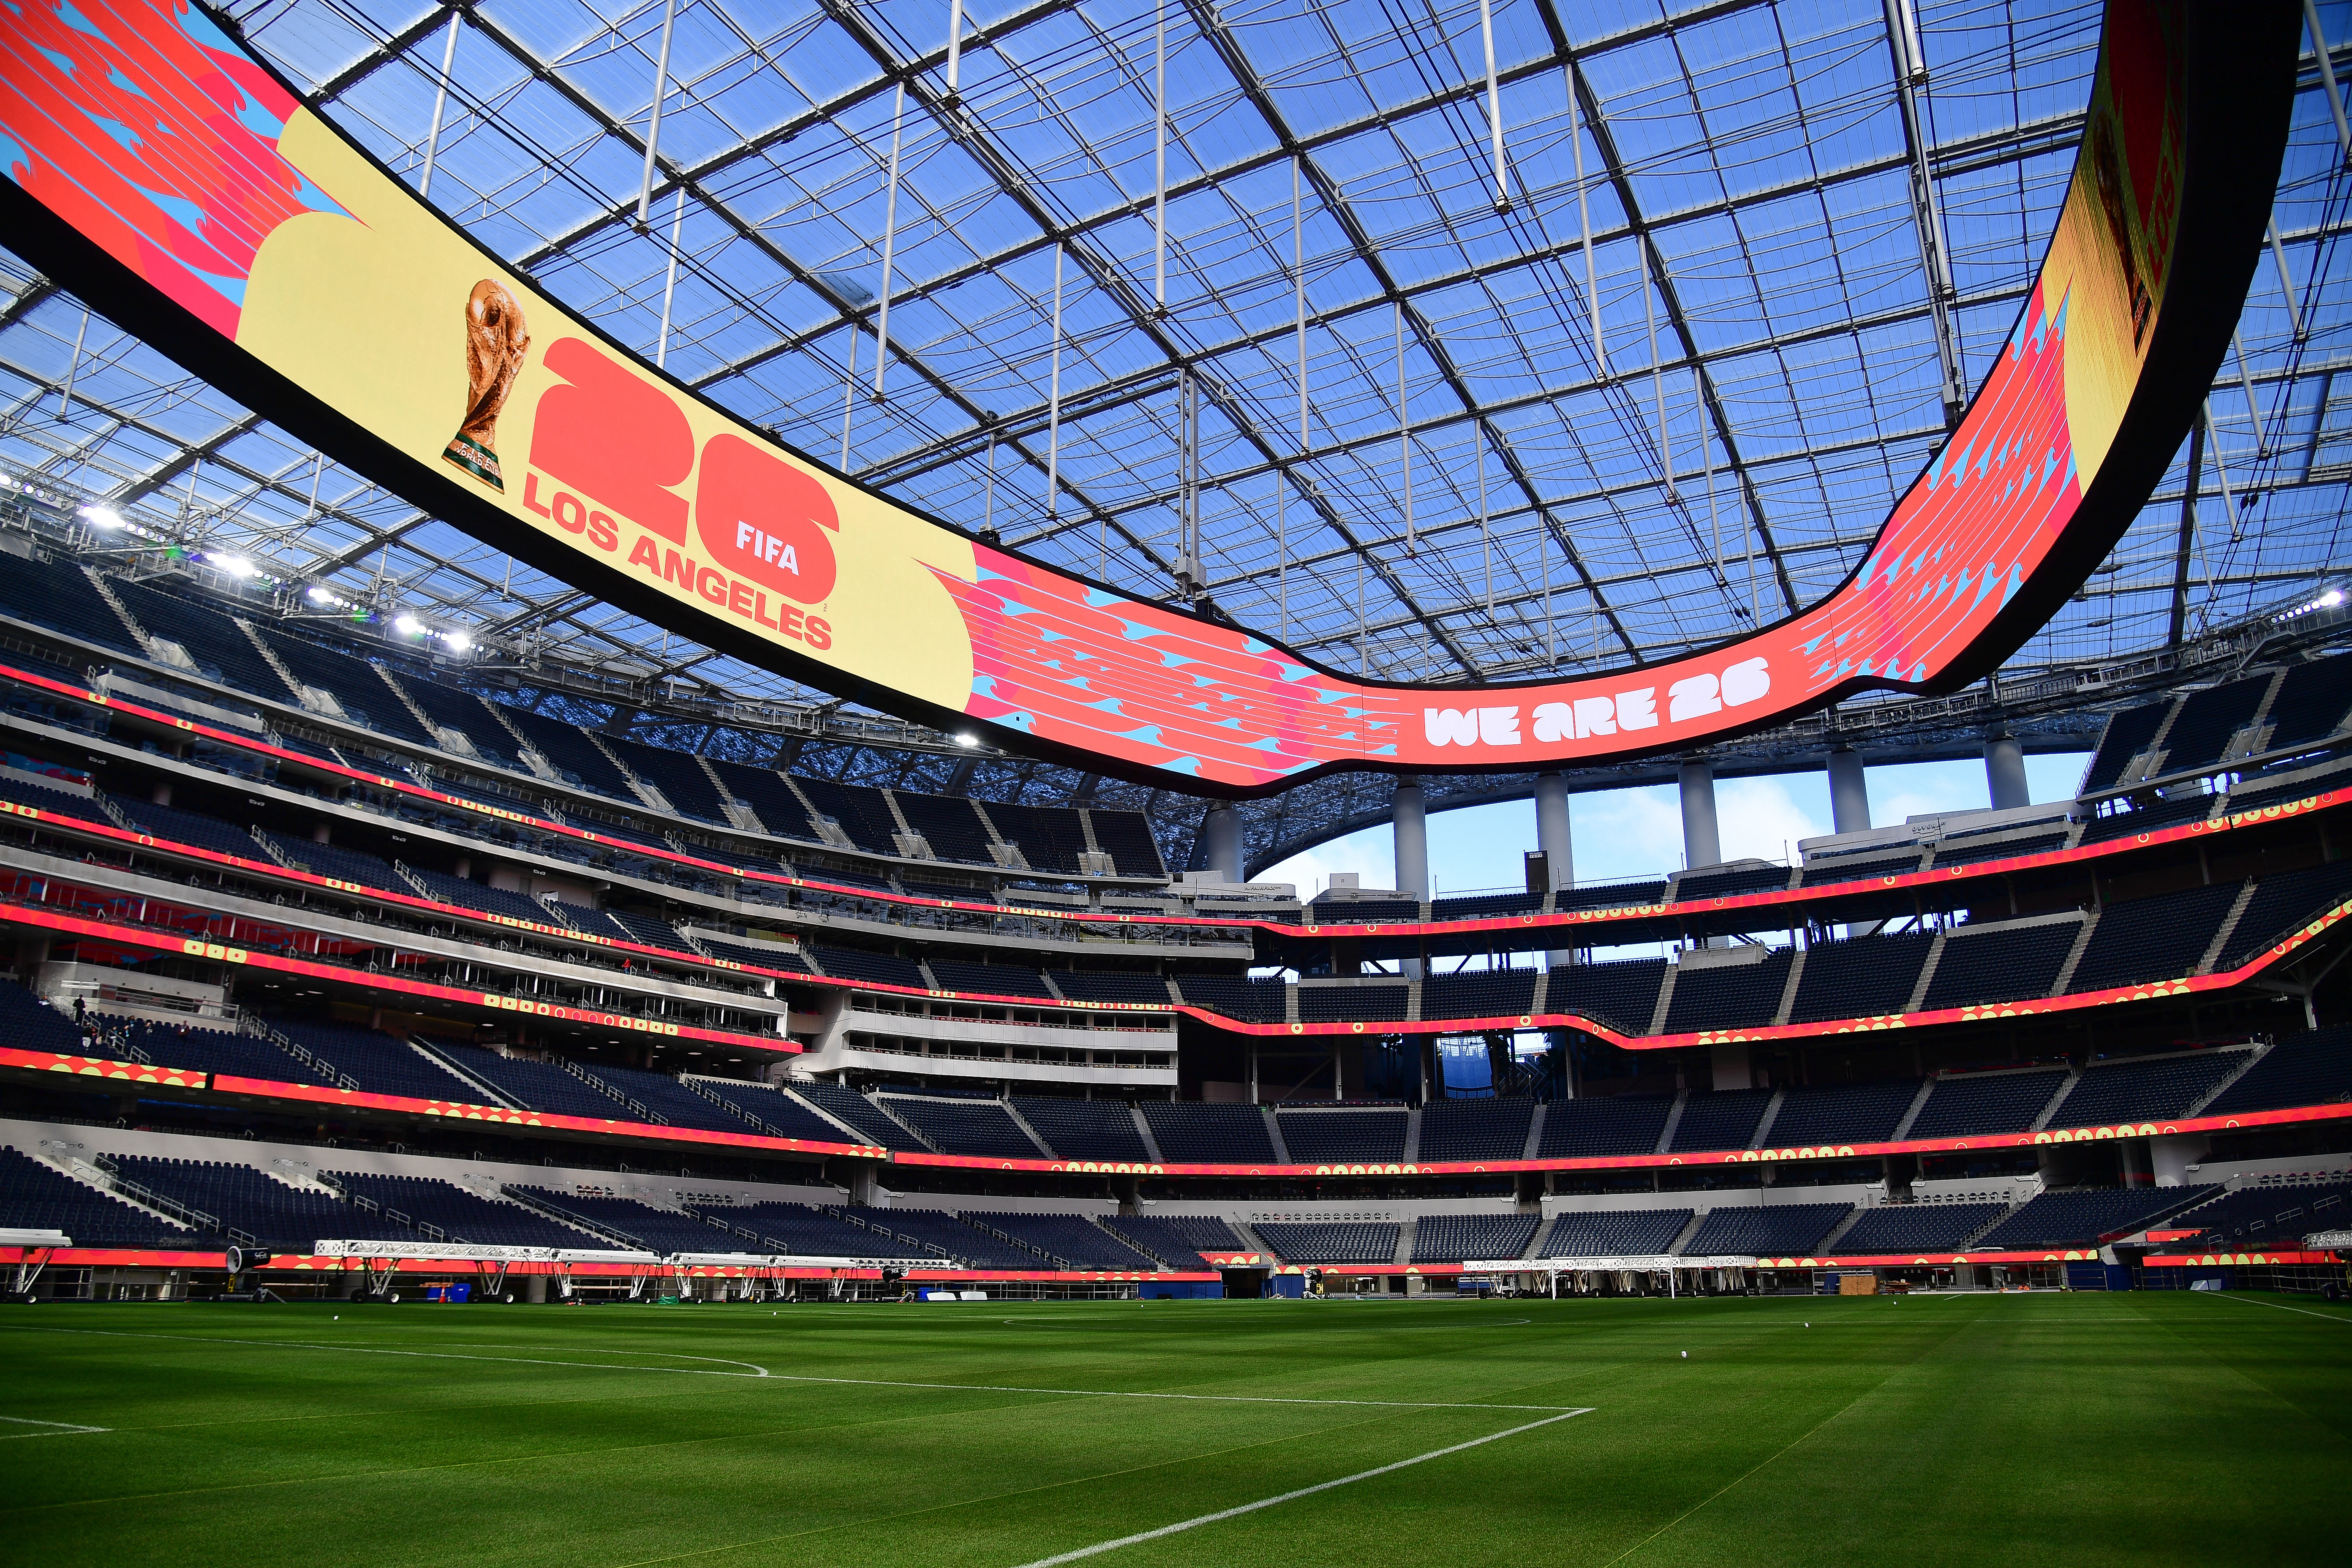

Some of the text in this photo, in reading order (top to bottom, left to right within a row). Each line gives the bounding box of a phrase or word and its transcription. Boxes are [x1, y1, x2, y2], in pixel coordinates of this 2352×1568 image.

[2148, 155, 2175, 288] LOS
[455, 446, 499, 476] WORLD CUP
[462, 443, 493, 467] FIFA
[529, 337, 840, 605] 26
[523, 471, 832, 651] LOS ANGELES
[736, 520, 800, 577] FIFA
[1424, 706, 1522, 747] WE
[1668, 656, 1771, 724] 26
